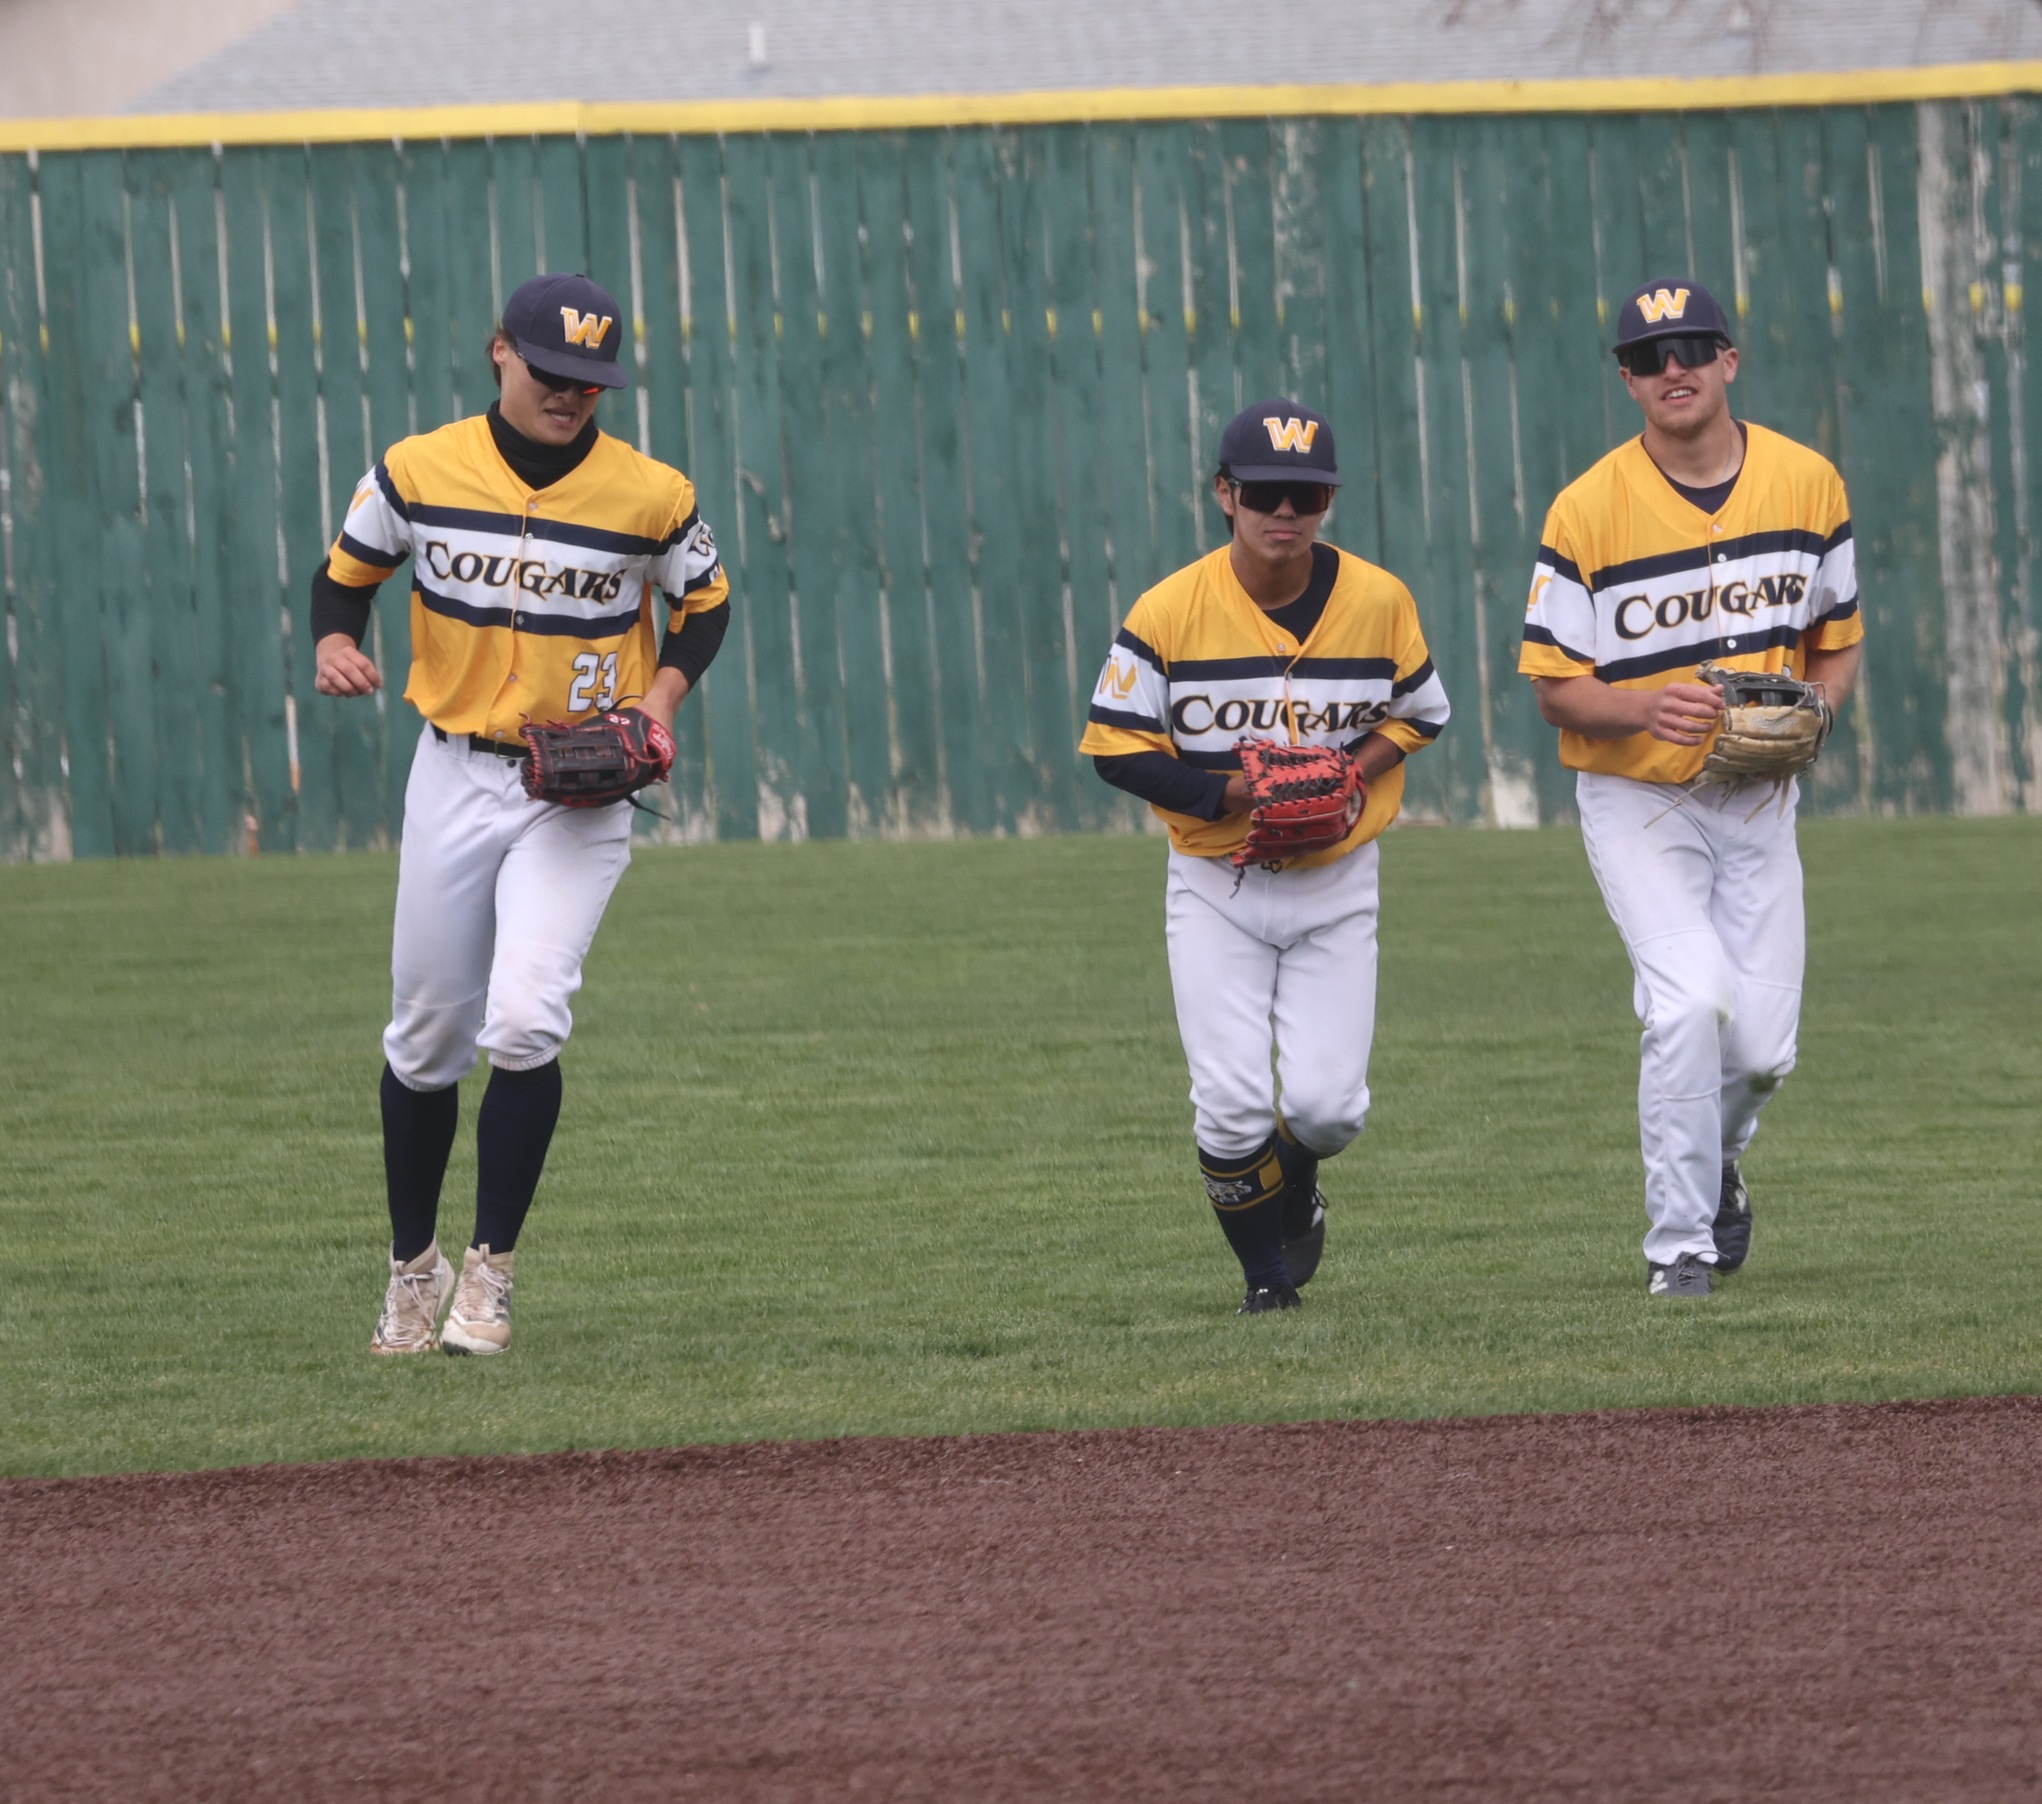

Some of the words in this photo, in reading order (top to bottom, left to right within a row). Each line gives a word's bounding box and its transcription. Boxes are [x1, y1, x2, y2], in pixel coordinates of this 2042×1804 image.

[1636, 288, 1690, 323] W
[560, 306, 612, 349] W
[1263, 417, 1318, 453] W
[425, 541, 628, 606] COUGARS
[567, 652, 618, 712] 23
[1172, 694, 1390, 737] COUGARS
